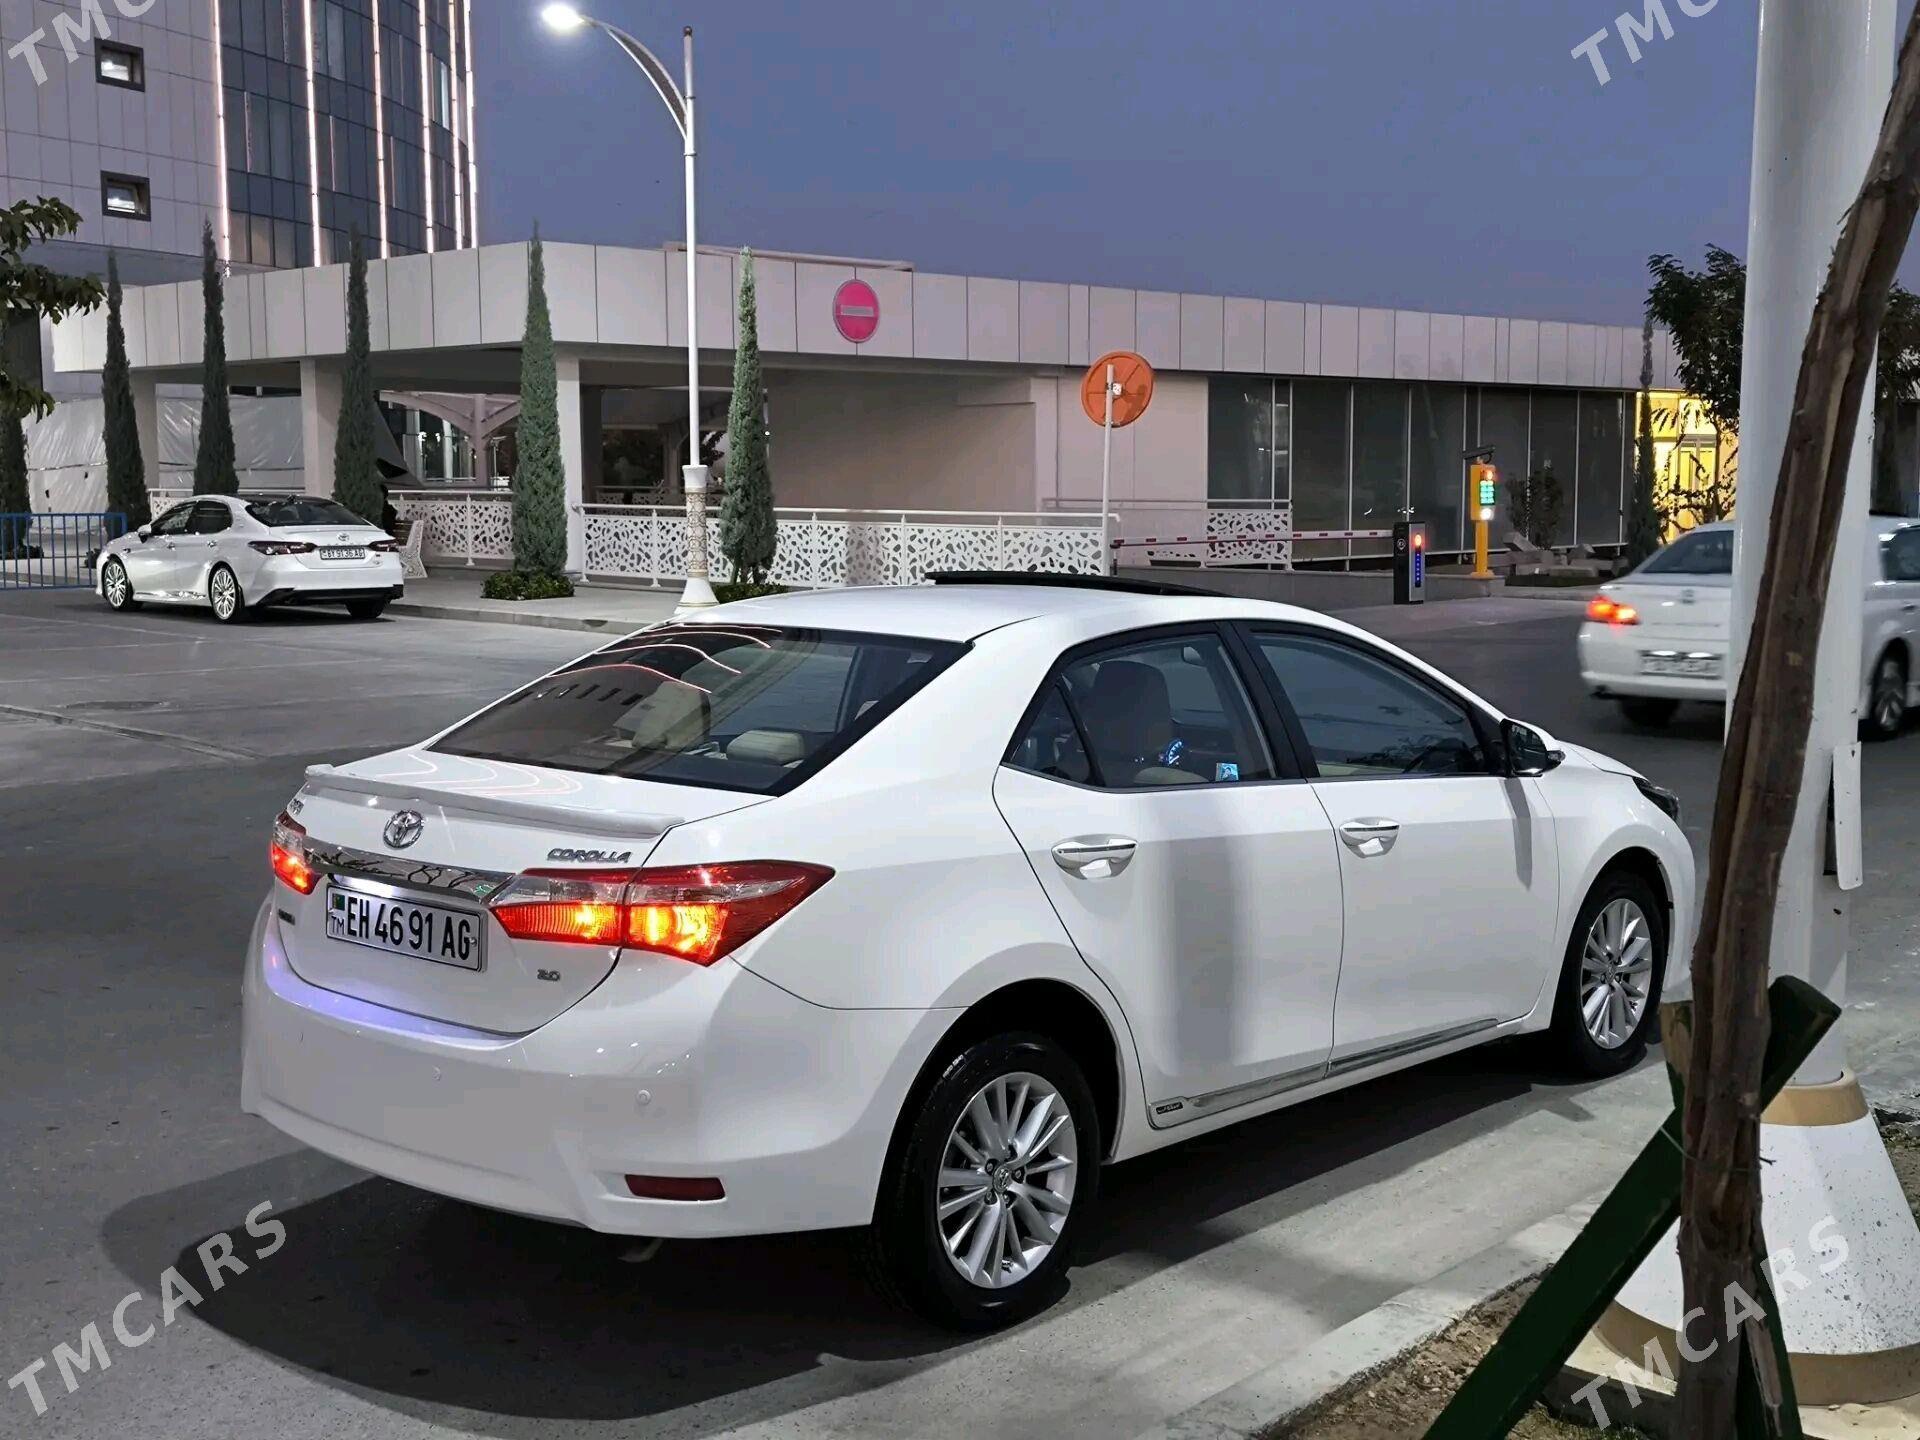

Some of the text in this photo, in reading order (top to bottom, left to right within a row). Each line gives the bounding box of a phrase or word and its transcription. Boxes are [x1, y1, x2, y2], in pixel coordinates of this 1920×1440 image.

[547, 848, 632, 863] COROLLA
[331, 915, 345, 936] TM
[347, 896, 370, 939] EH
[374, 903, 404, 946] 46
[408, 909, 434, 953] 91
[441, 916, 471, 961] AG
